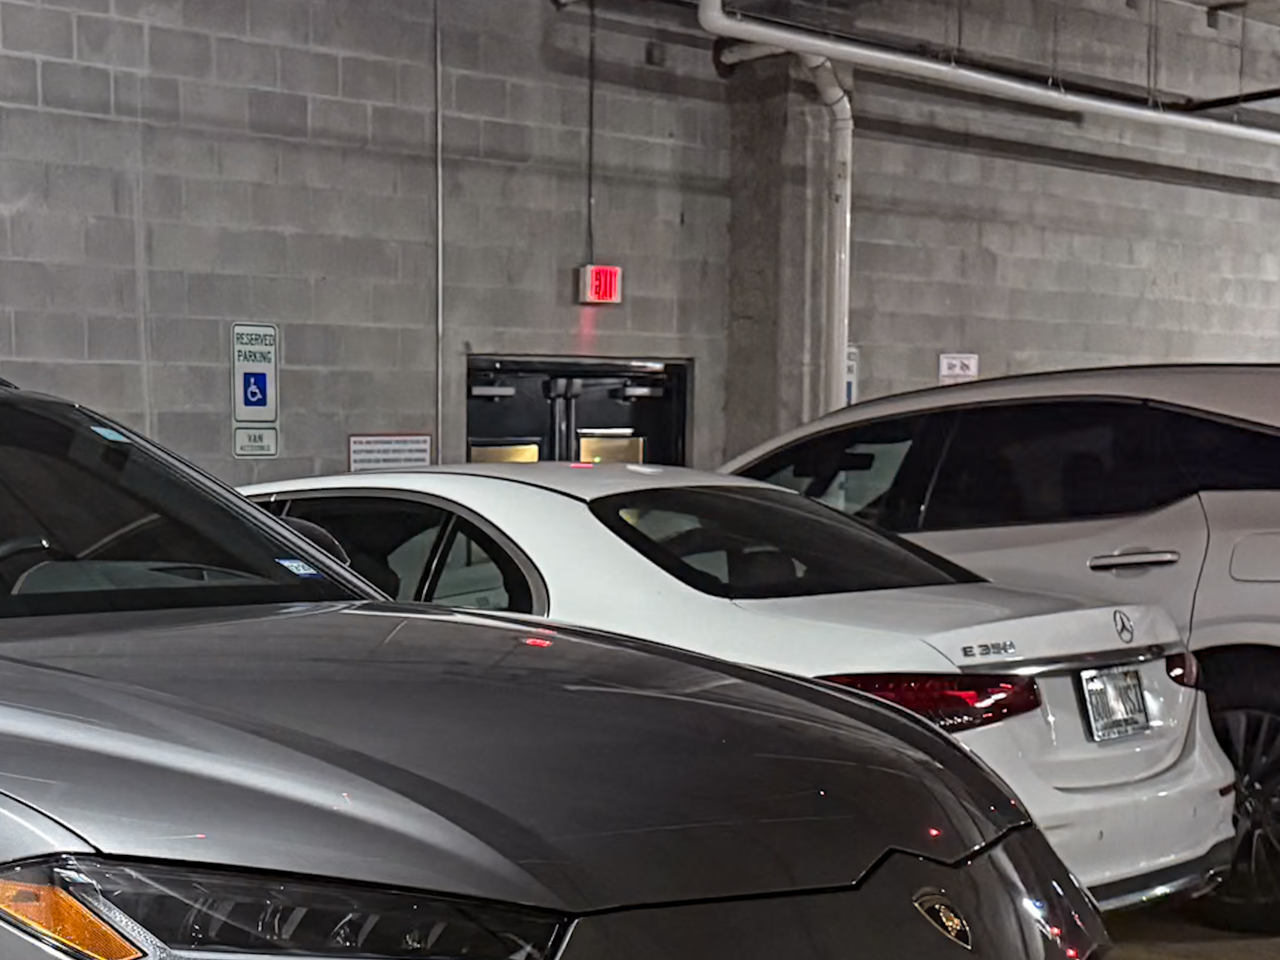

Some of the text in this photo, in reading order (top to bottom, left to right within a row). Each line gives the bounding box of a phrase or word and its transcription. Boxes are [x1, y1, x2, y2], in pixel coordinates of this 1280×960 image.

[235, 332, 275, 347] RESERVED
[237, 350, 272, 363] PARKING
[247, 433, 264, 443] VAN
[962, 646, 976, 657] E
